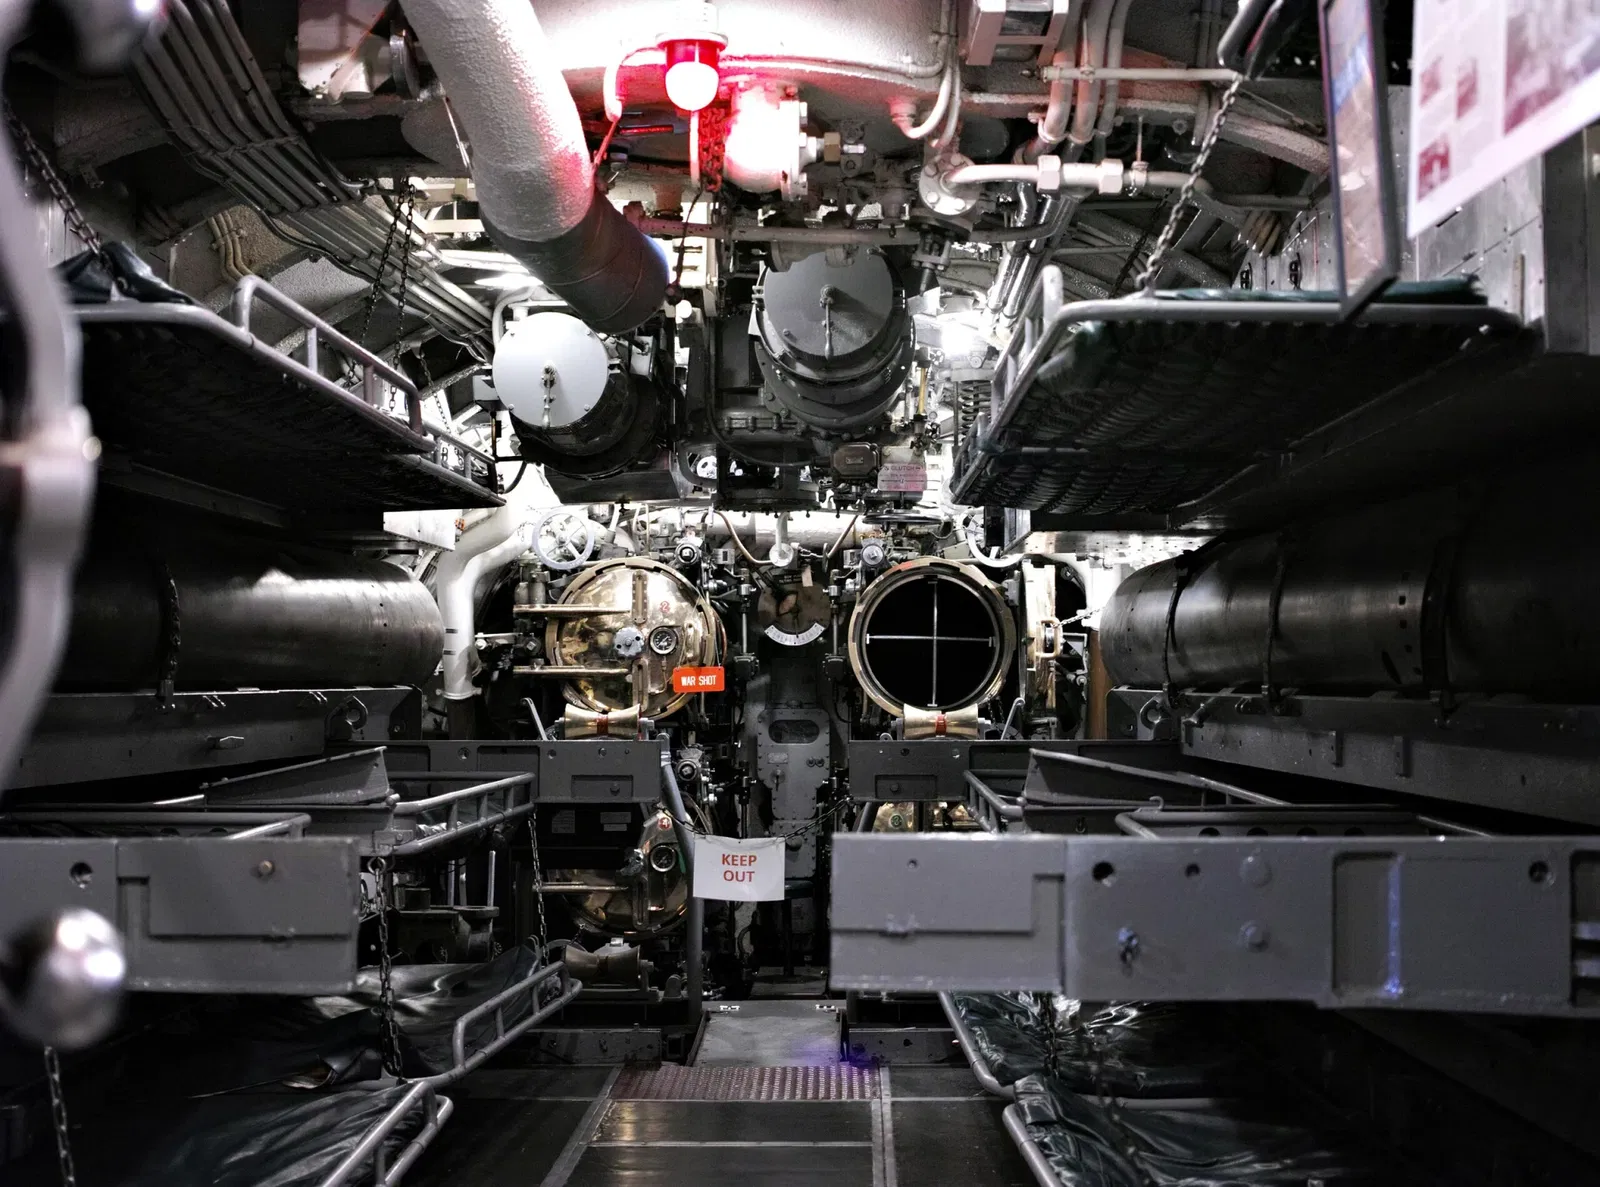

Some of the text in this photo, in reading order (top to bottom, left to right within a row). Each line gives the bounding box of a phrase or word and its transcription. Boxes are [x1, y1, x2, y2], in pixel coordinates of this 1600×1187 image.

[681, 674, 717, 686] WAR SHOT
[721, 853, 758, 867] KEEP
[723, 869, 756, 883] OUT
